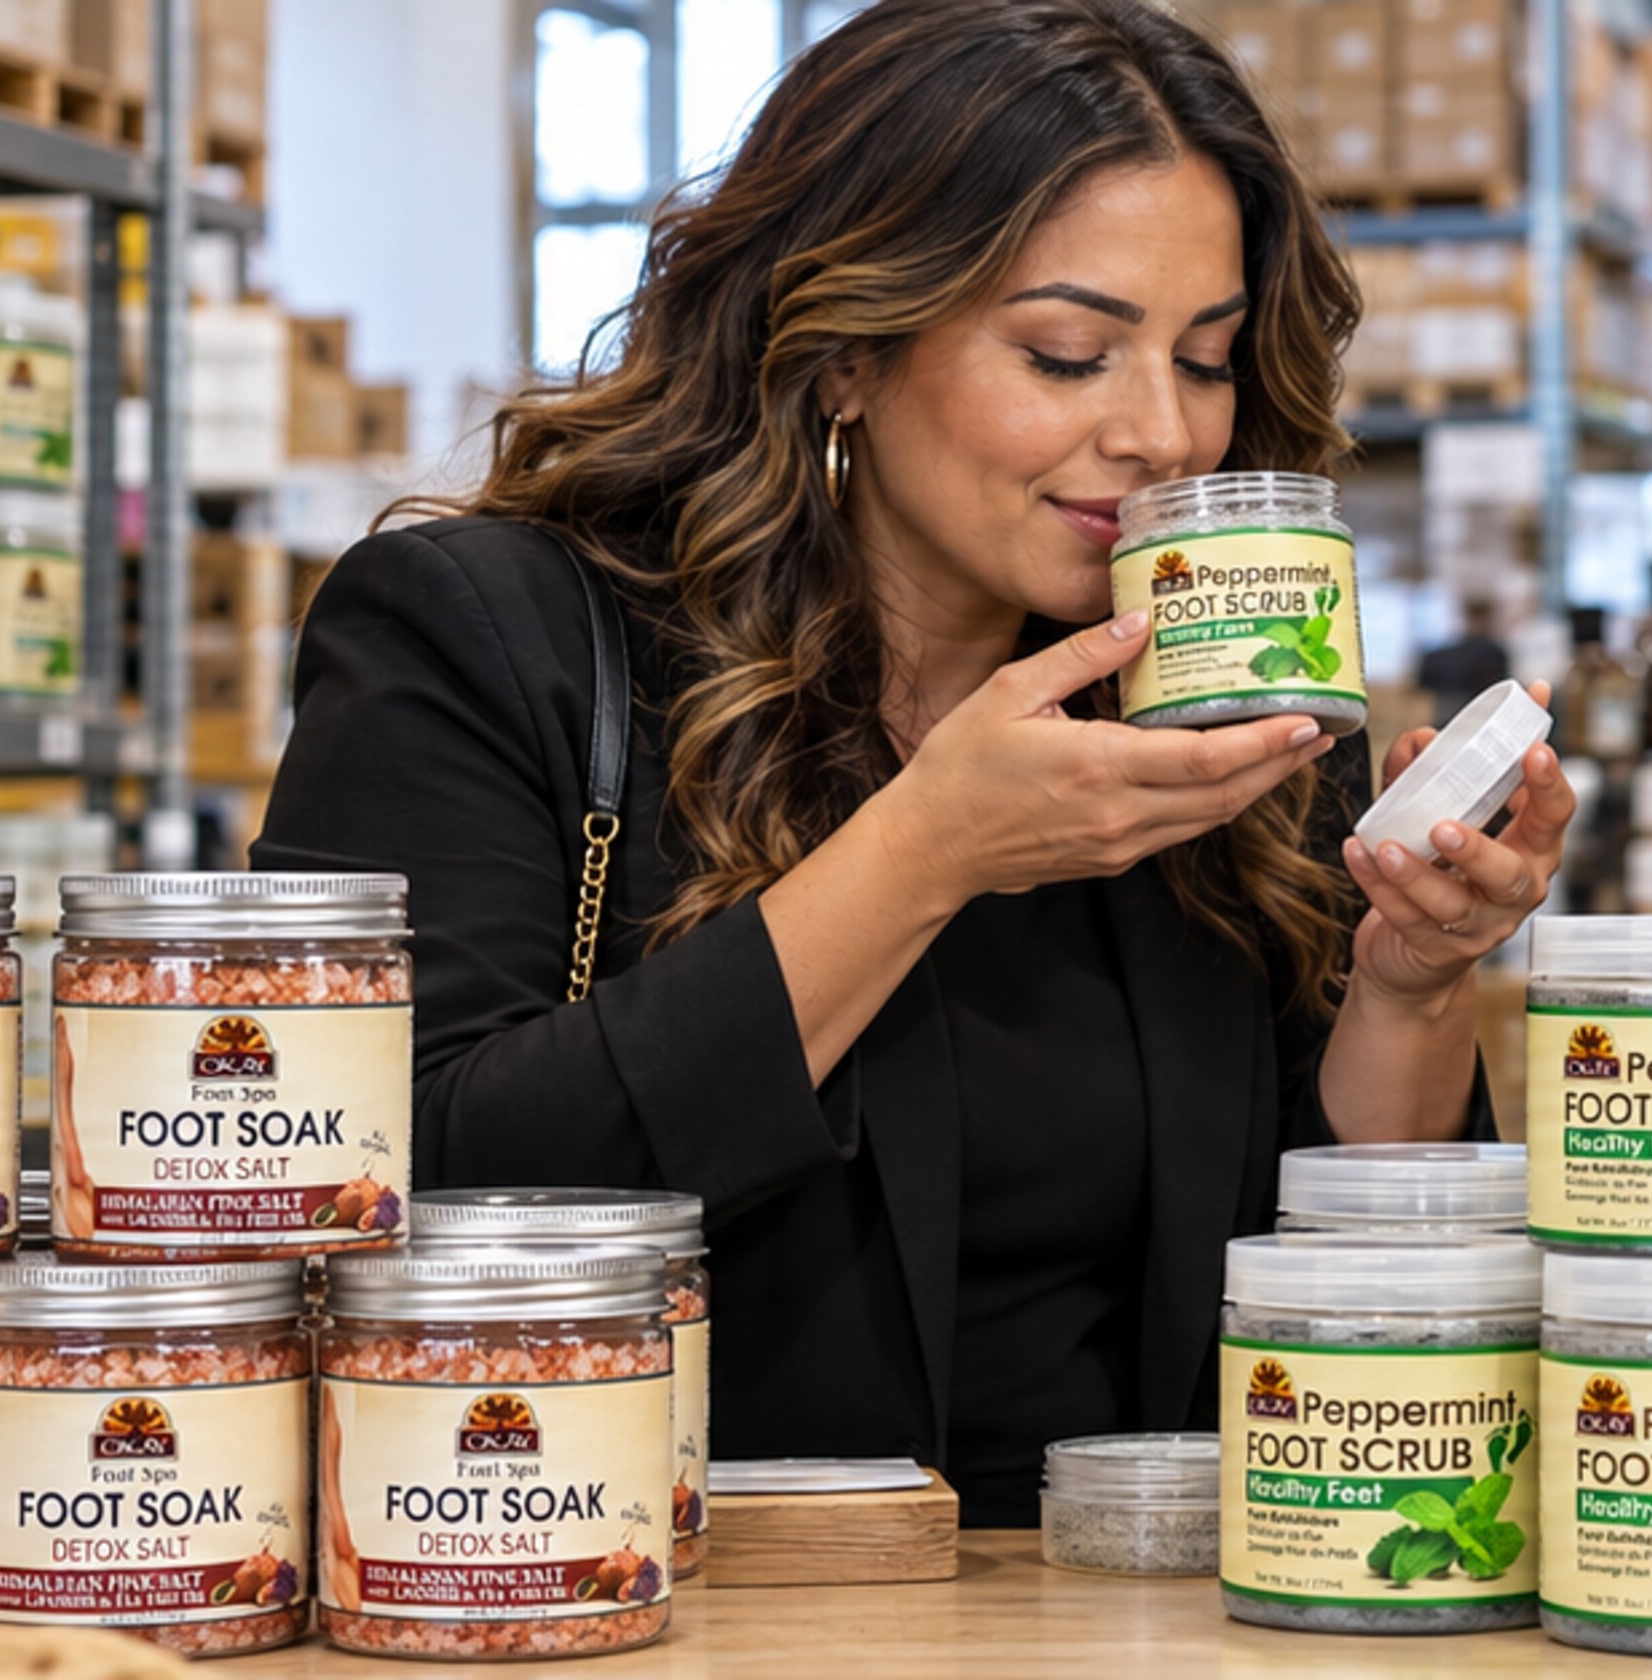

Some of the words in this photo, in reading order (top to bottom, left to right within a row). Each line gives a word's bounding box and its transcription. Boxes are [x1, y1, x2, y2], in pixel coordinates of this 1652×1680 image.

[1198, 563, 1330, 588] Peppermint
[1154, 595, 1217, 623] FOOT
[1565, 1093, 1651, 1125] FOOT
[120, 1109, 224, 1146] FOOT
[237, 1109, 344, 1146] SOAK
[154, 1157, 227, 1179] DETOX
[235, 1157, 289, 1178] SALT
[1304, 1391, 1516, 1433] Peppermint
[1248, 1431, 1327, 1470] FOOT
[1340, 1438, 1471, 1471] SCRUB
[19, 1492, 124, 1528] FOOT
[136, 1486, 242, 1528] SOAK
[386, 1485, 488, 1523] FOOT
[502, 1483, 605, 1522] SOAK
[52, 1538, 128, 1562] DETOX
[137, 1536, 190, 1560] SALT
[418, 1532, 493, 1556] DETOX
[501, 1532, 553, 1554] SALT
